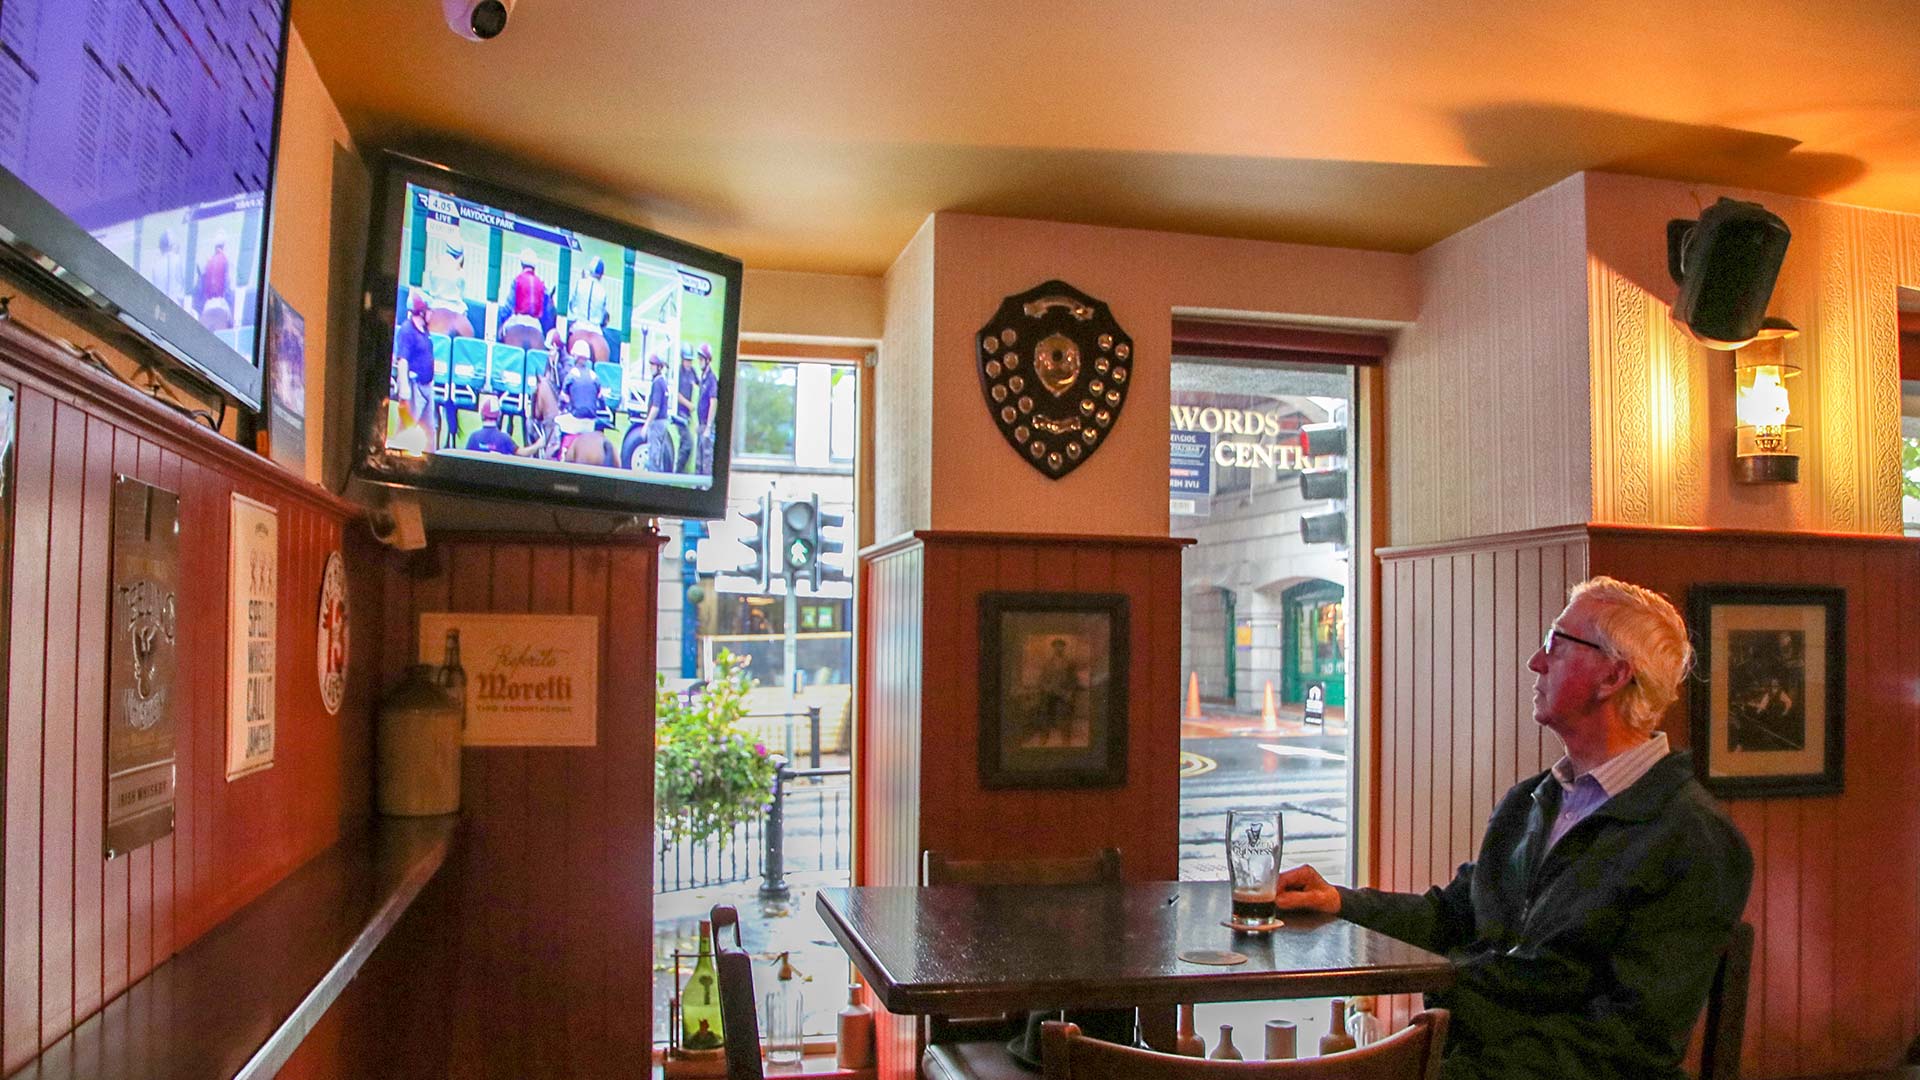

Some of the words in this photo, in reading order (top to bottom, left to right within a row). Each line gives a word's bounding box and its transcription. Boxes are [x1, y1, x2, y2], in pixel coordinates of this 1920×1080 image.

[432, 199, 452, 213] 4.05
[434, 212, 452, 224] LIVE
[460, 206, 495, 225] HAYDOCK
[495, 217, 516, 231] PARK
[1213, 440, 1330, 470] CENTR
